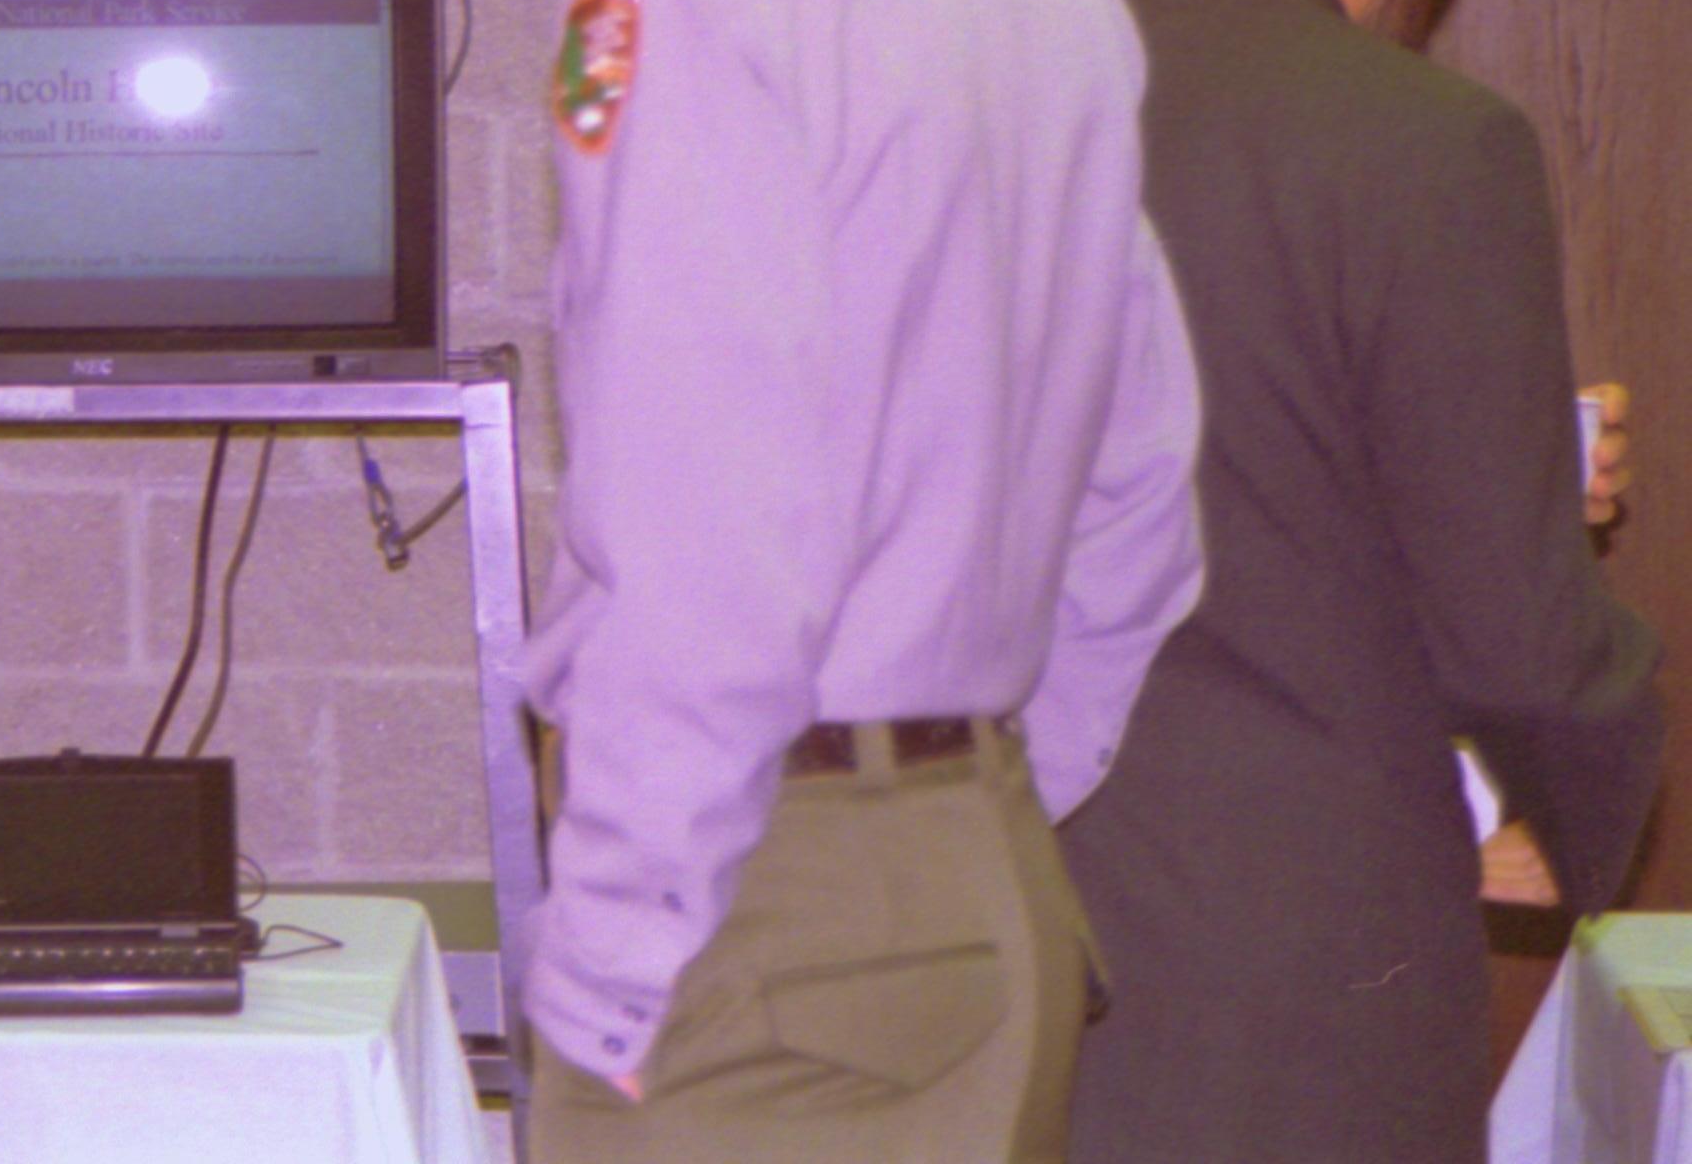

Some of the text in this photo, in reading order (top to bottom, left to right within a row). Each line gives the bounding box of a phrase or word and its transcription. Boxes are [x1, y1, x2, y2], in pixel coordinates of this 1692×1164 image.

[104, 1, 157, 24] Park
[166, 0, 246, 23] Service
[66, 118, 163, 144] Historic
[73, 359, 115, 376] NEC
